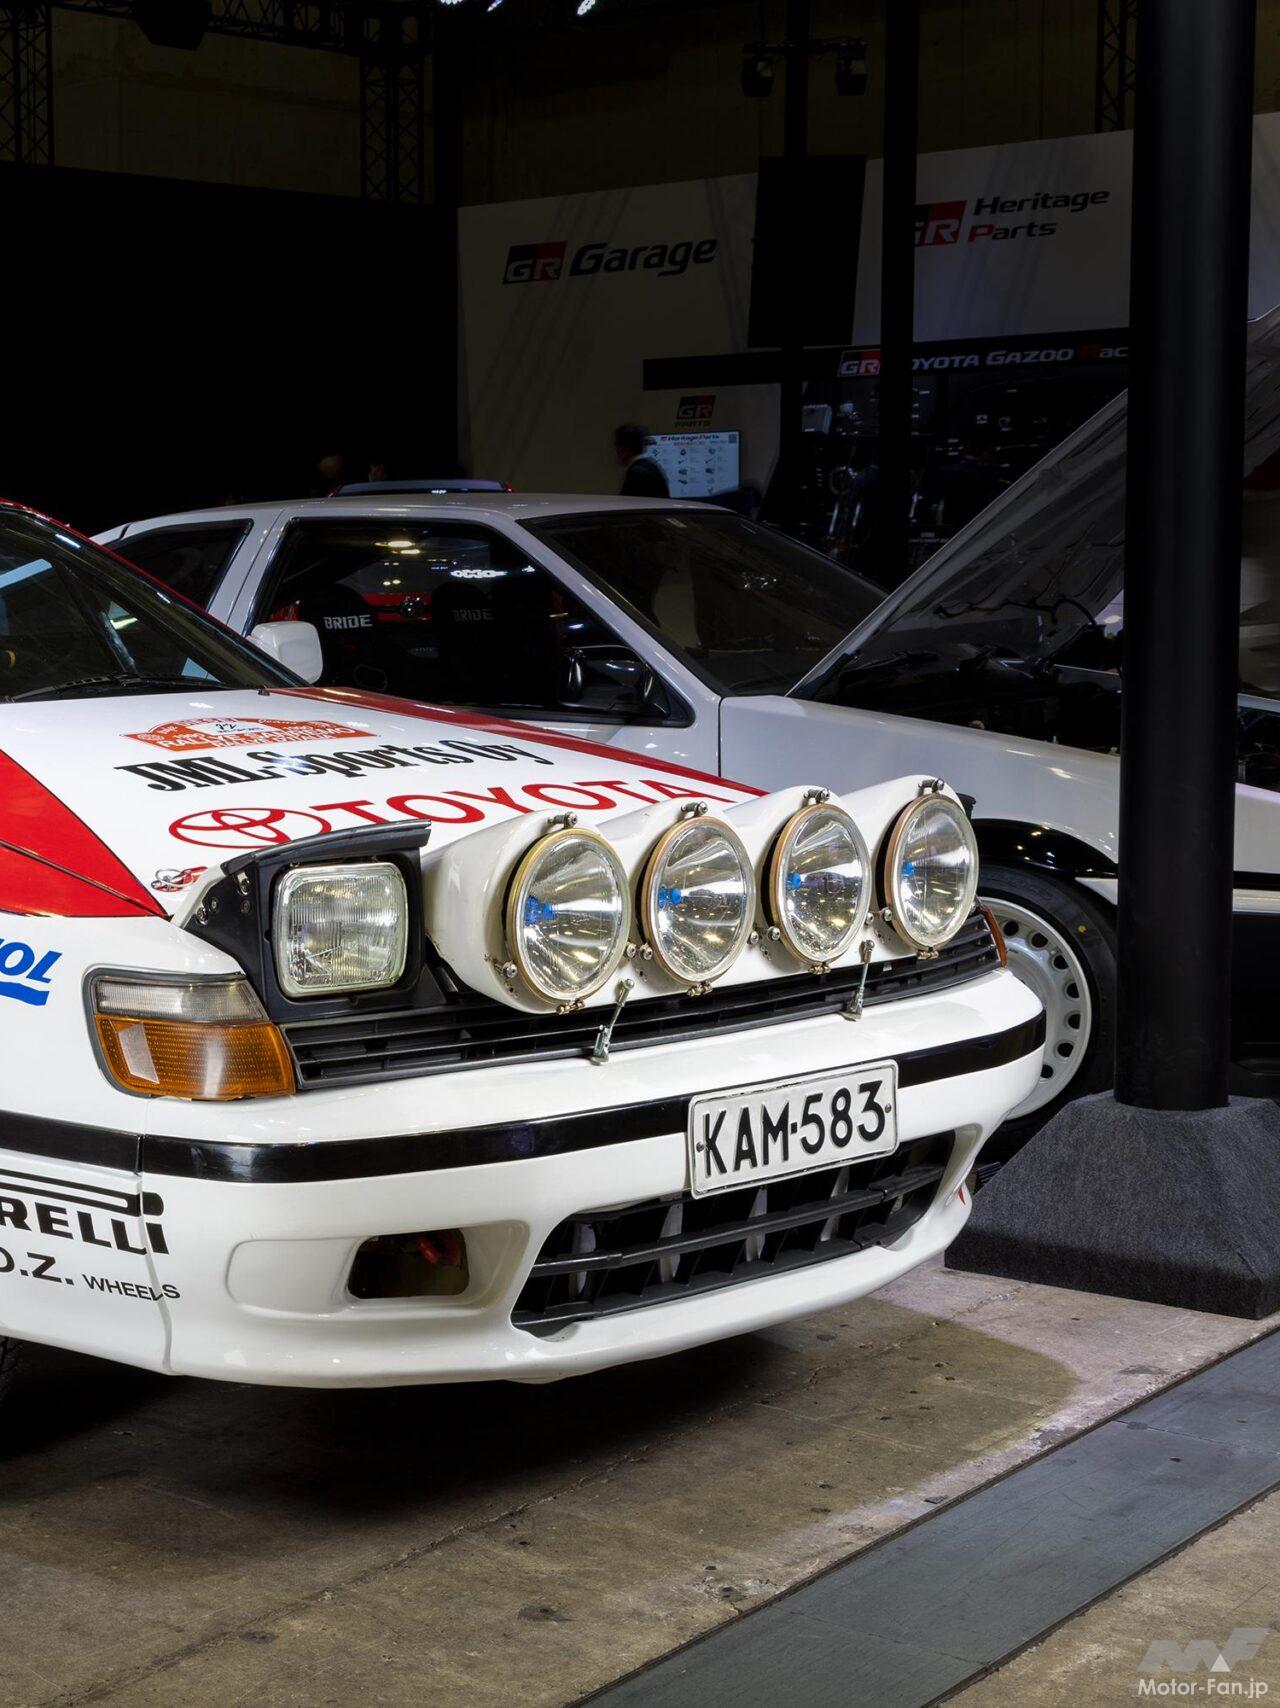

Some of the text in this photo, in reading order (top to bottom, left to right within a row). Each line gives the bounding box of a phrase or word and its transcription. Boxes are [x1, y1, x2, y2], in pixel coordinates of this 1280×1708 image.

[974, 191, 1110, 215] Heritage
[968, 221, 1058, 242] Parts
[506, 239, 718, 281] GR Garage
[323, 614, 373, 630] BRIDE
[452, 608, 494, 622] BRIDE
[309, 779, 738, 825] TOYOTA
[703, 1079, 887, 1179] KAM-583
[82, 1273, 182, 1302] WHEELS
